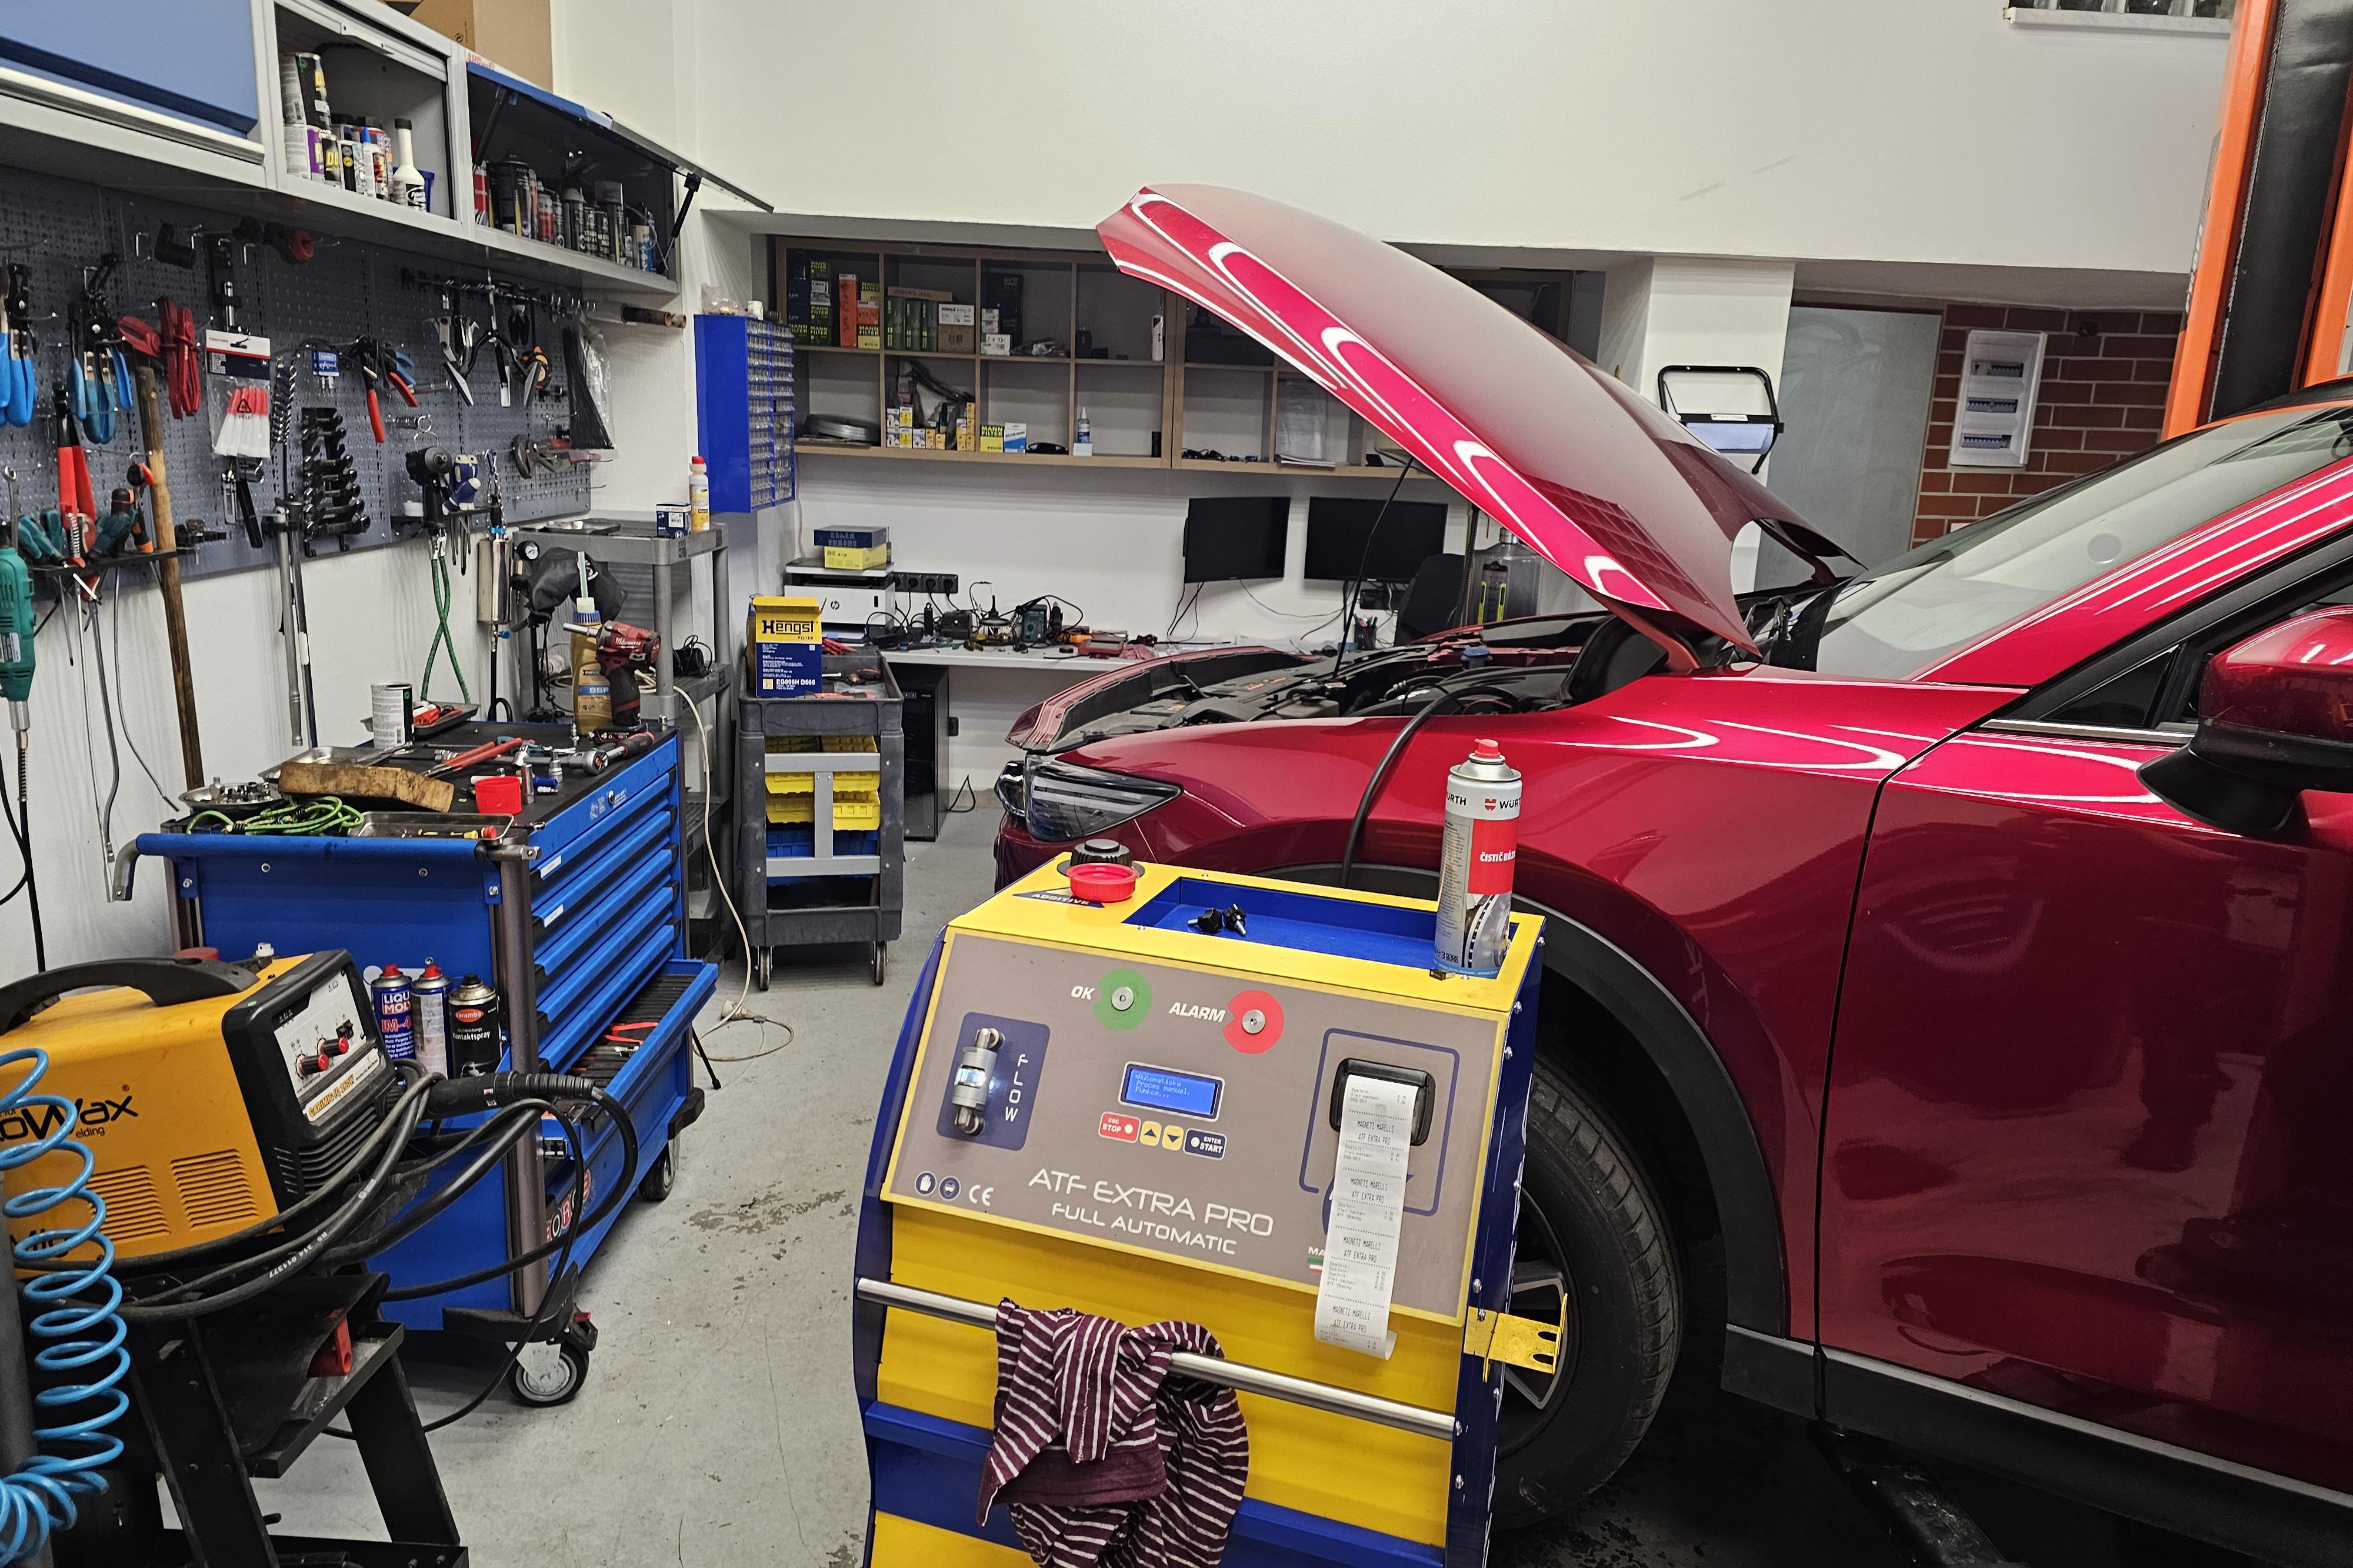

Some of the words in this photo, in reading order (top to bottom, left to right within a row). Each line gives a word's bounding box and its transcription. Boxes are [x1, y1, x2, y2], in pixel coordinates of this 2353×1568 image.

[762, 620, 814, 635] Hengst
[615, 638, 641, 646] Milwaukee
[1479, 851, 1504, 862] ČISTIČ
[1031, 893, 1091, 906] ADDITIVE
[1071, 985, 1096, 1000] OK
[1168, 1002, 1227, 1022] ALARM
[452, 1030, 491, 1041] Kontaktspray
[1005, 1053, 1029, 1122] FLOW
[1102, 1123, 1122, 1133] STOP
[1357, 1119, 1375, 1130] MAGNETI
[1377, 1122, 1394, 1133] MARELLI
[1203, 1136, 1222, 1144] ENTER
[1368, 1134, 1381, 1144] EXTRA
[1382, 1136, 1391, 1146] PRO
[1199, 1142, 1224, 1154] START
[1351, 1177, 1368, 1188] MAGNETI
[1370, 1180, 1388, 1192] MARELLI
[1028, 1167, 1087, 1195] ATF
[1092, 1180, 1195, 1222] EXTRA
[1204, 1202, 1274, 1236] PRO
[1351, 1190, 1359, 1199] ATF
[1361, 1192, 1374, 1202] EXTRA
[1376, 1195, 1384, 1204] PRO
[1052, 1202, 1106, 1227] FULL
[1111, 1215, 1237, 1255] AUTOMATIC
[1344, 1236, 1361, 1247] MAGNETI
[1363, 1239, 1381, 1251] MARELLI
[1353, 1250, 1367, 1261] EXTRA
[1368, 1253, 1377, 1263] PRO
[1332, 1305, 1351, 1317] MAGNETI
[1352, 1309, 1371, 1321] MARELLI
[1333, 1319, 1341, 1327] ATF
[1343, 1320, 1356, 1331] EXTRA
[1358, 1323, 1367, 1333] PRO
